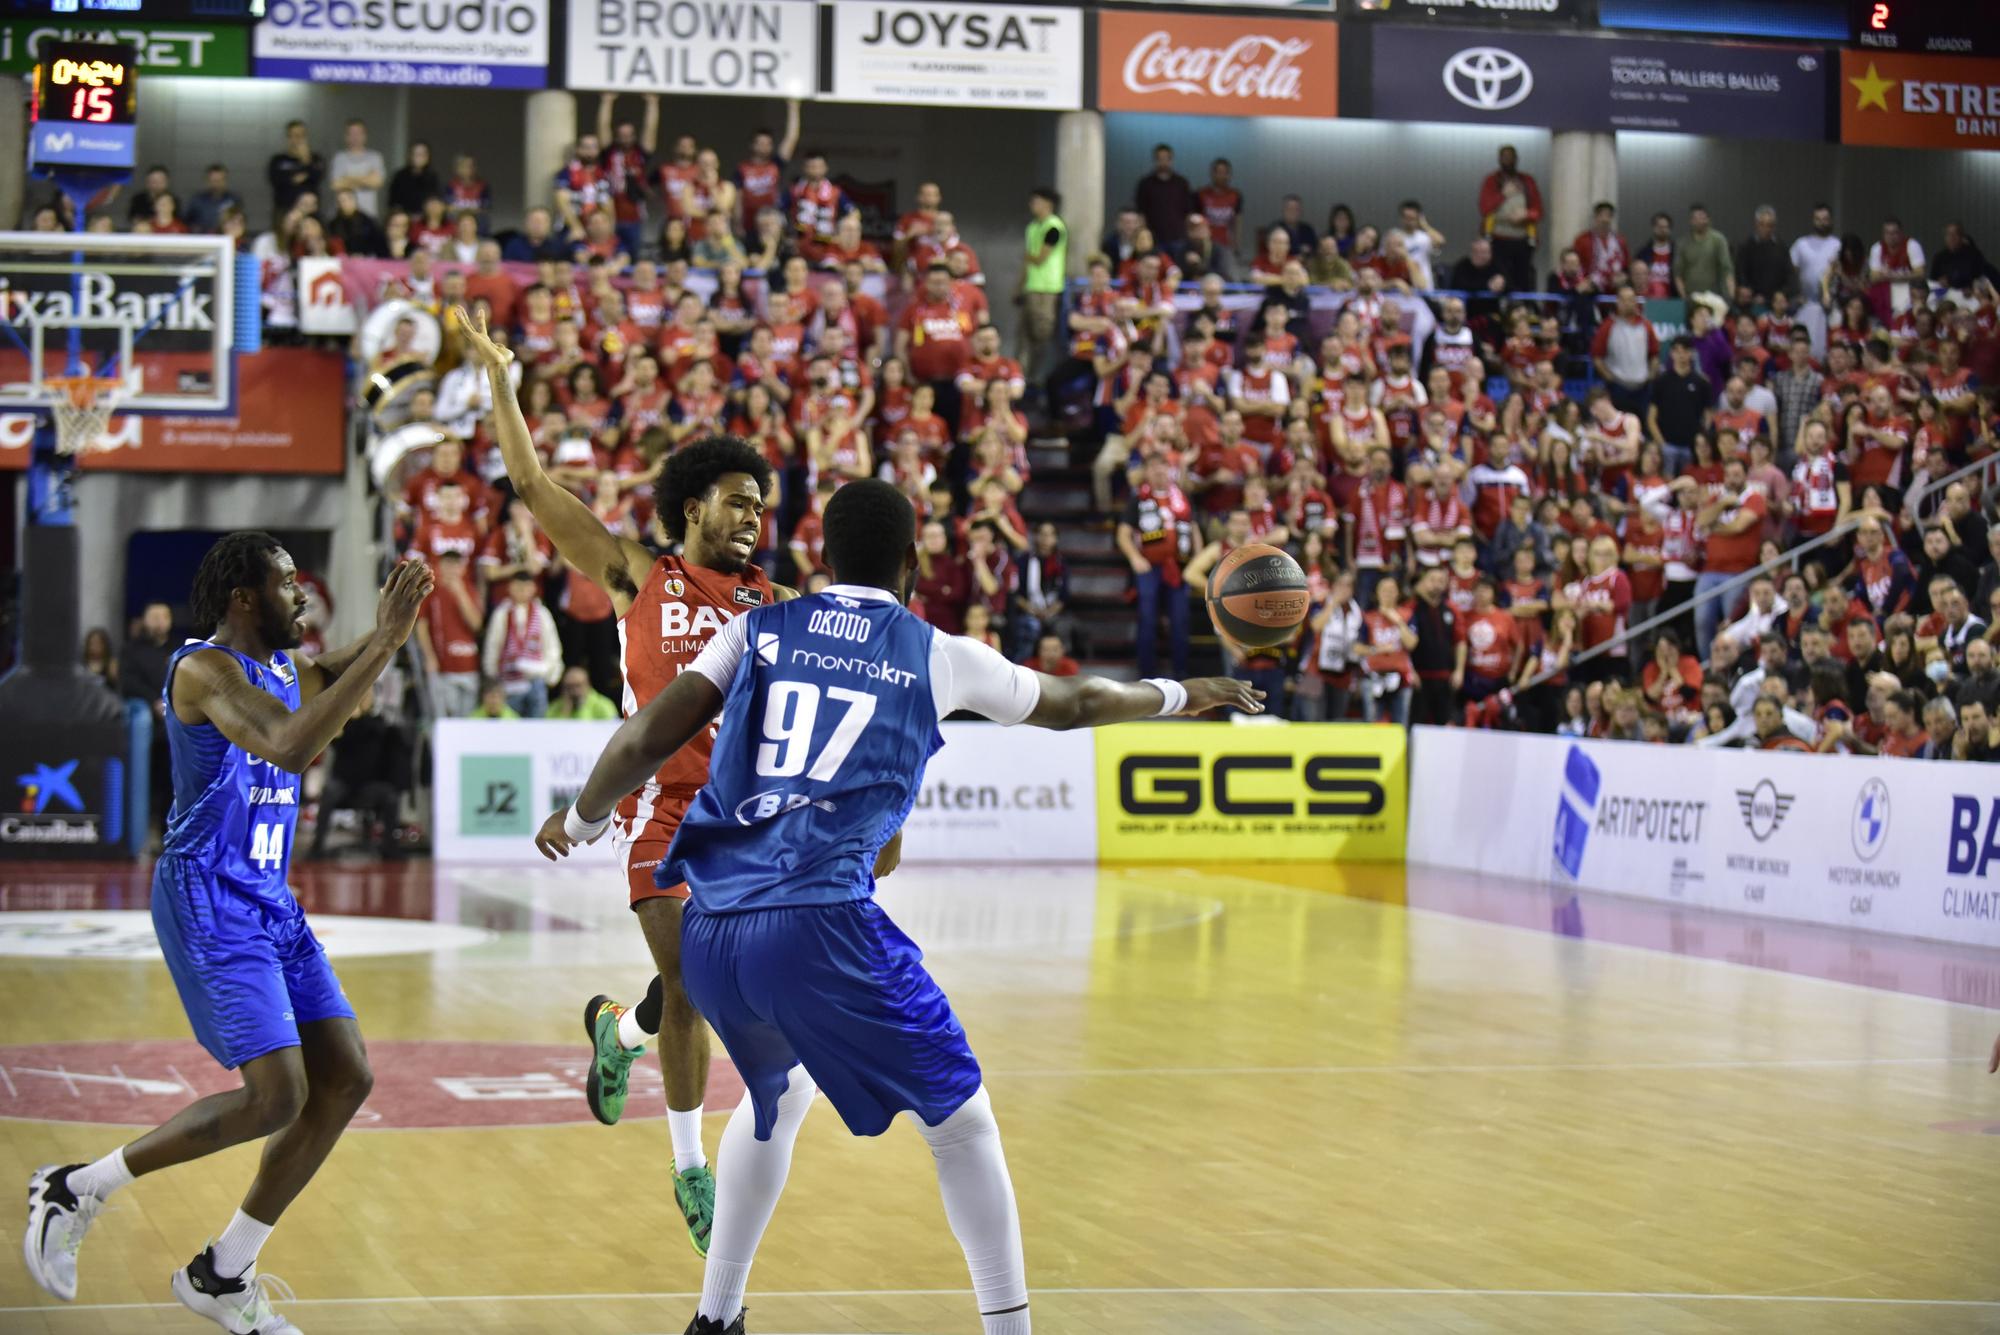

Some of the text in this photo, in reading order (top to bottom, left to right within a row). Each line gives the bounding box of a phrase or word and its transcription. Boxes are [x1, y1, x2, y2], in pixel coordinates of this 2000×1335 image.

[598, 0, 780, 42] BROWN
[861, 10, 1057, 51] JOYSAT
[1871, 3, 1889, 29] 2
[1860, 31, 1898, 48] FALTES
[597, 44, 779, 89] TAILOR
[1611, 66, 1667, 84] TOYOTA
[1670, 69, 1726, 88] TALLERS
[71, 87, 114, 122] 15
[1903, 80, 2000, 116] ESTRE
[1956, 116, 2000, 136] DAM
[807, 609, 871, 643] OKOUO
[661, 640, 709, 654] CLIMA
[755, 680, 878, 783] 97
[1119, 755, 1386, 816] GCS
[249, 823, 284, 869] 44
